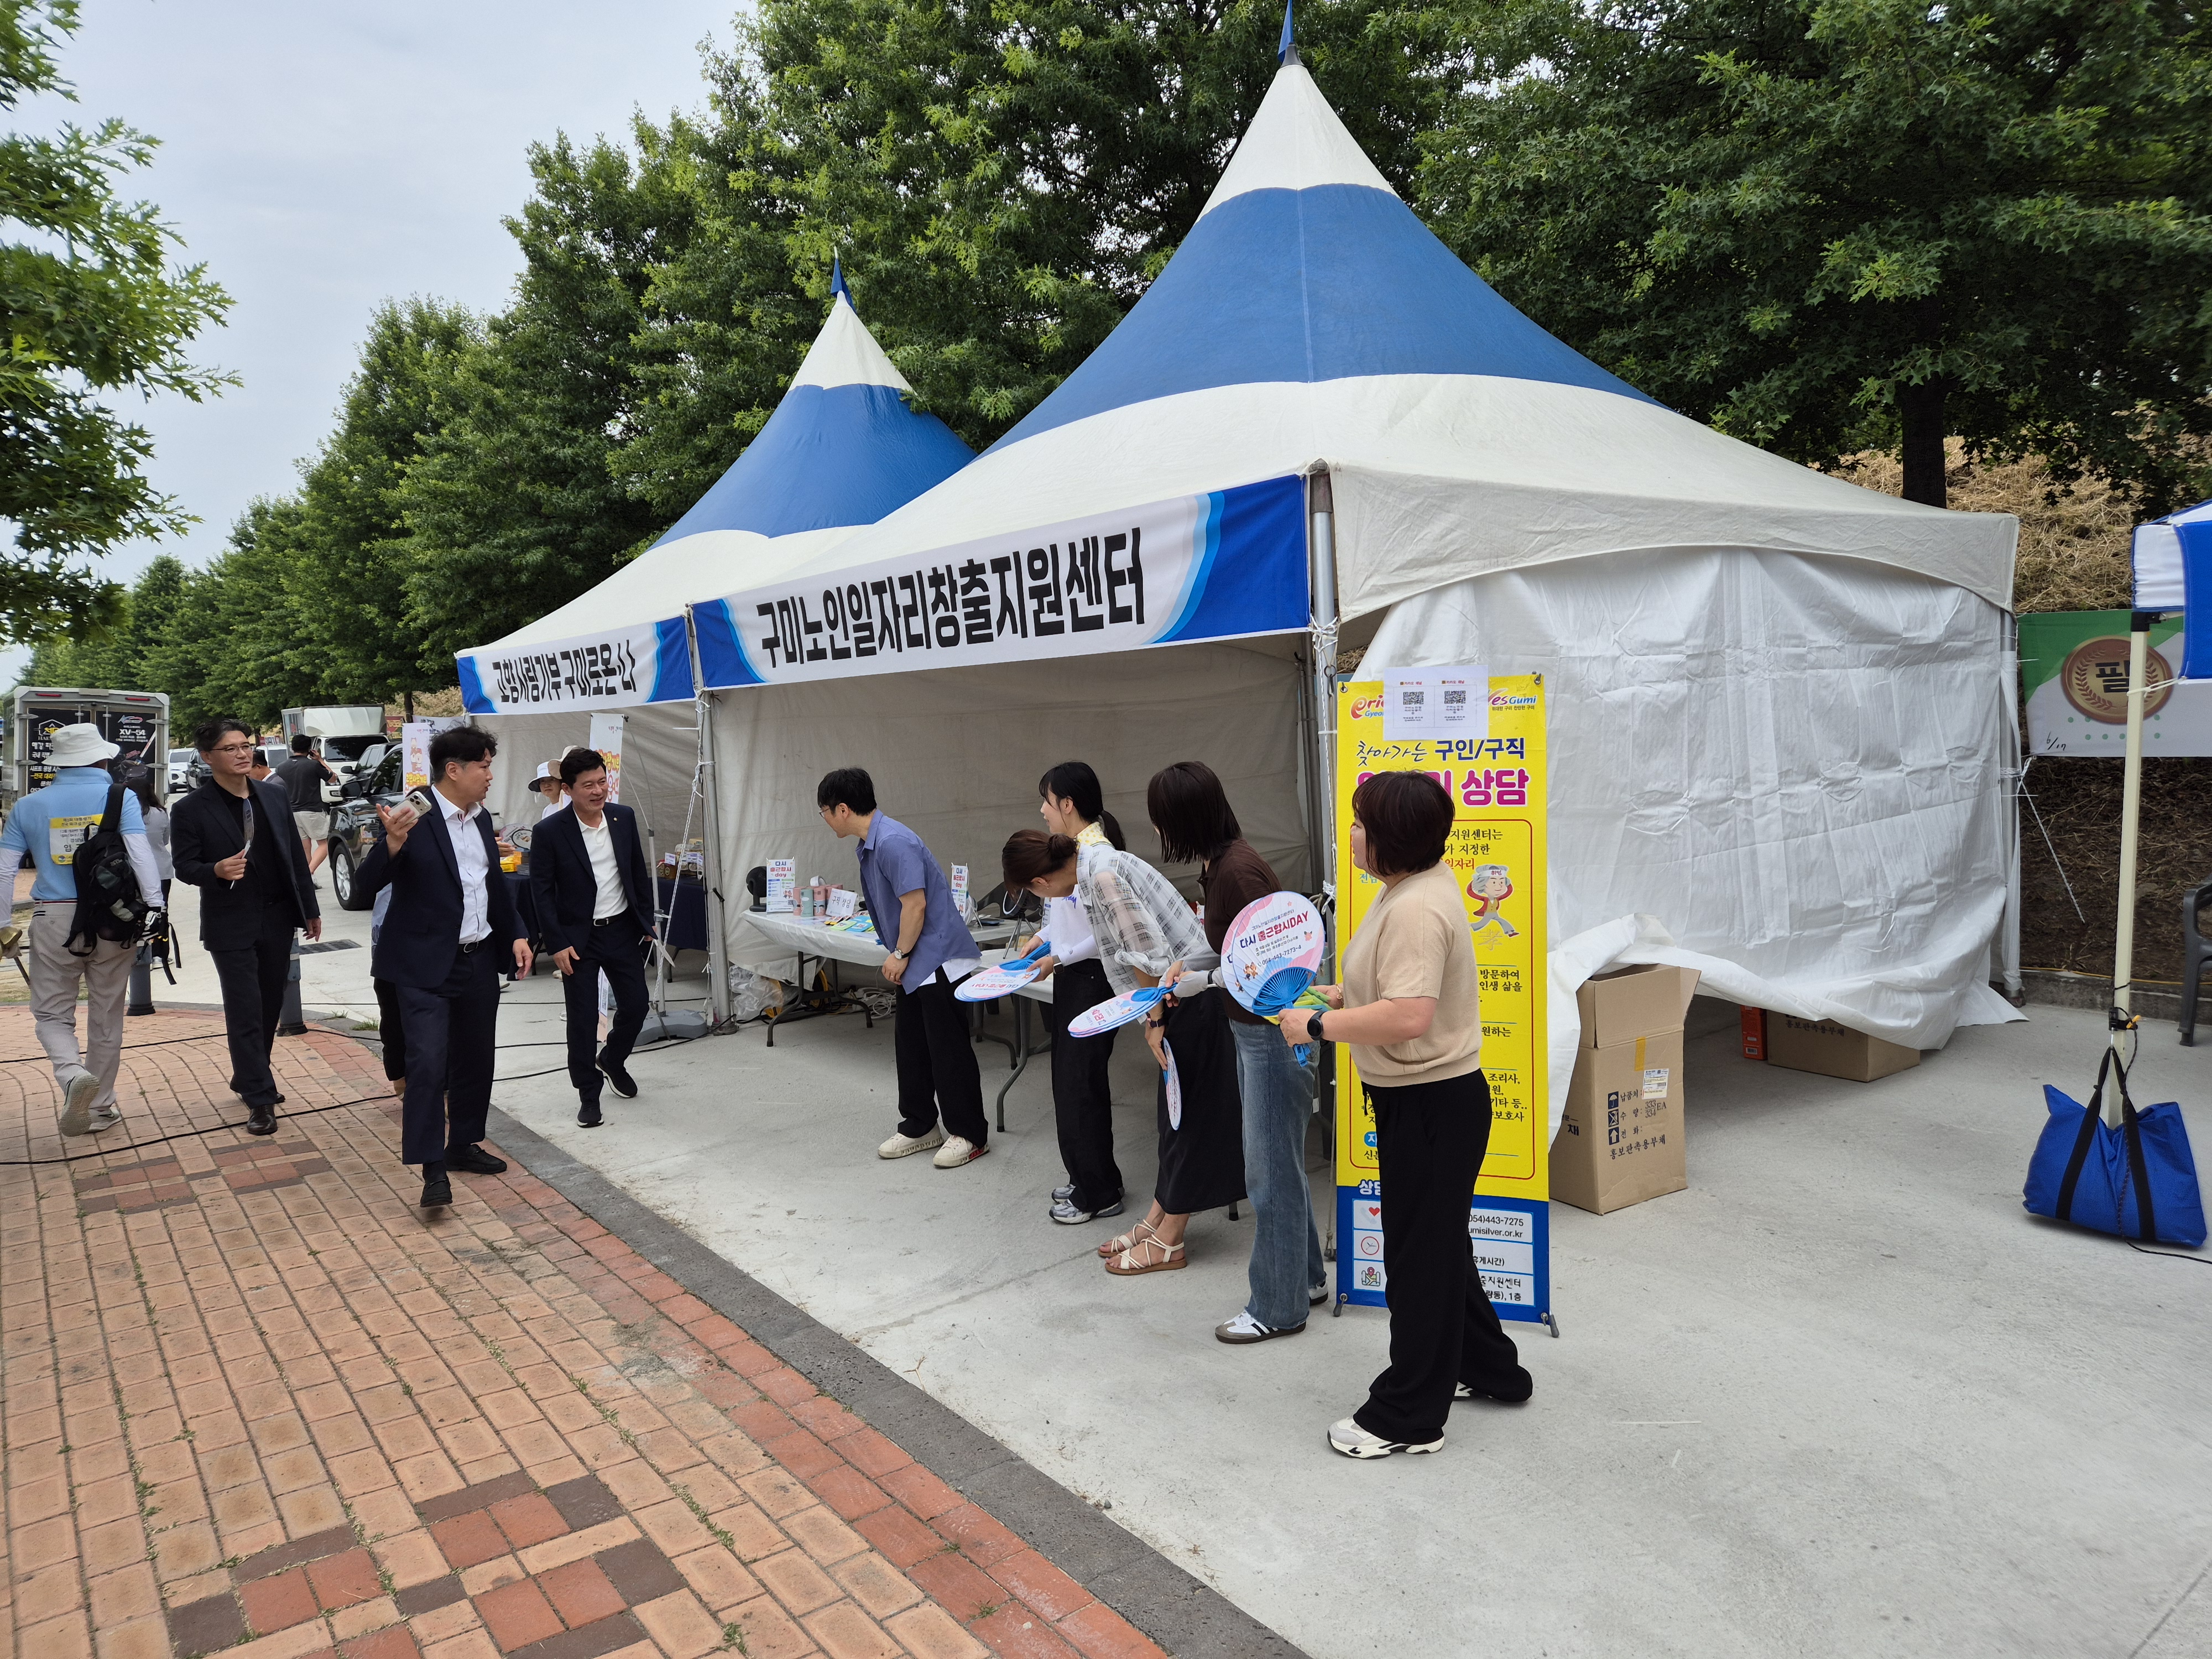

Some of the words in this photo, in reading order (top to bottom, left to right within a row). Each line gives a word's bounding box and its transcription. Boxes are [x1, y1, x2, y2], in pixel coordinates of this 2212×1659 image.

[757, 527, 1145, 668] 구미노인일자리창출지원센터
[492, 652, 561, 703] 고향사랑기부
[1509, 696, 1536, 704] Gumi
[1357, 740, 1427, 766] 찾아가는
[1435, 738, 1524, 761] 구인/구직
[1461, 769, 1529, 806] 상담
[1446, 829, 1503, 841] 지원센터는
[1459, 843, 1490, 855] 지정한
[1441, 858, 1475, 870] 일자리
[832, 896, 841, 905] 구직
[842, 899, 851, 908] 상담
[1239, 933, 1256, 948] 다시
[1258, 911, 1308, 942] 출근합시DAY
[1480, 969, 1519, 980] 방문하여
[1479, 980, 1498, 990] 인생
[1502, 981, 1522, 992] 삶을
[1488, 1073, 1520, 1084] 조리사,
[1488, 1084, 1504, 1095] 원,
[1620, 1089, 1638, 1102] 납품처
[1645, 1100, 1656, 1109] 333
[1657, 1102, 1667, 1111] EA
[1492, 1111, 1524, 1122] 보호사
[1568, 1124, 1579, 1136] 채
[1610, 1134, 1666, 1160] 홍보판촉용부채
